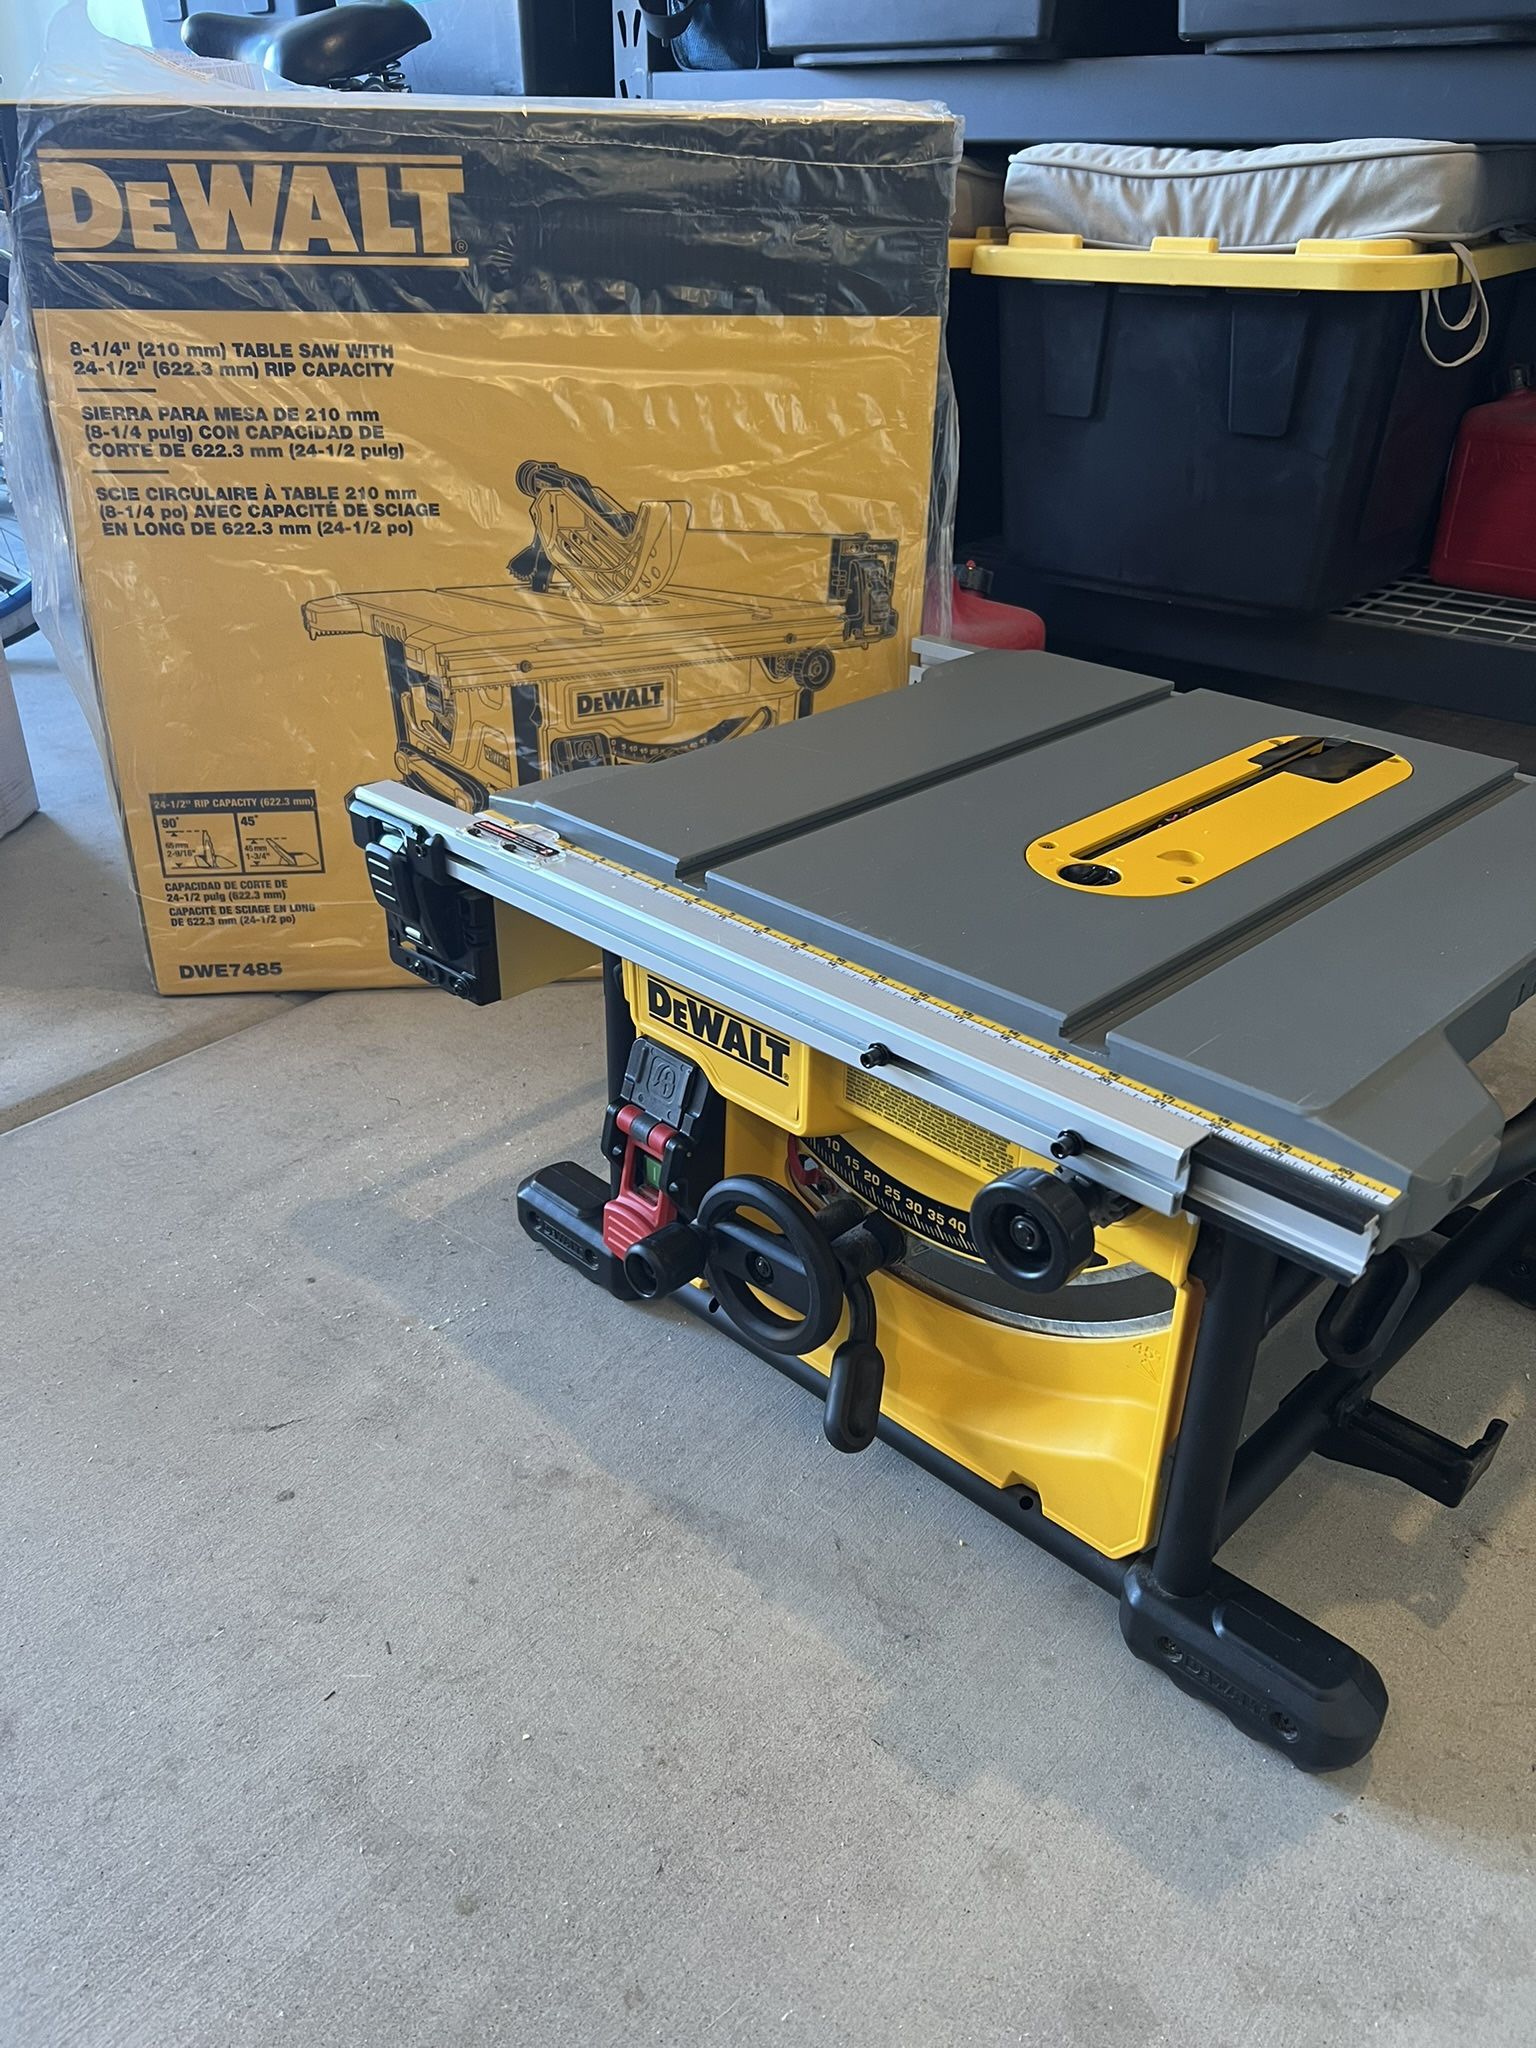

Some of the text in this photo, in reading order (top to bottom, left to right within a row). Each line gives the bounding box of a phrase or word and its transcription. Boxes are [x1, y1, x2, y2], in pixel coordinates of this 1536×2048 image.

[70, 342, 394, 358] 8-1/4" (210 mm) TABLE SAW WITH
[73, 361, 394, 379] 24-1/2" (622.3 mm) RIP CAPACITY
[82, 407, 379, 422] SIERRA PARA MESA DE 210 mm
[85, 425, 384, 442] (8-1/4 pulg) CON CAPACIDAD DE
[88, 443, 404, 460] CORTE DE 622.3 mm (24-1/2 pulg)
[96, 482, 416, 501] SCIE CIRCULAIRE À TABLE 210 mm
[100, 500, 440, 521] (8-1/4 po) AVEC CAPACITÉ DE SCIAGE
[102, 521, 413, 537] EN LONG DE 622.3 mm (24-1/2 po)
[154, 797, 314, 809] 24-1/2" RIP CAPACITY (622.3 mm)
[165, 880, 288, 891] CAPACIDAD DE CORTE DE
[167, 890, 286, 903] 24-1/2 pulg (622.3 mm)
[219, 906, 232, 915] DE
[235, 905, 270, 914] SCIAGE
[274, 905, 286, 913] EN
[290, 904, 315, 912] LONG
[171, 918, 184, 927] DE
[187, 917, 215, 926] 622.3
[240, 915, 277, 926] (24-1/2
[280, 914, 296, 924] po)
[179, 963, 282, 979] DWE7485
[825, 1138, 966, 1234] 10 15 20 25 30 35 40
